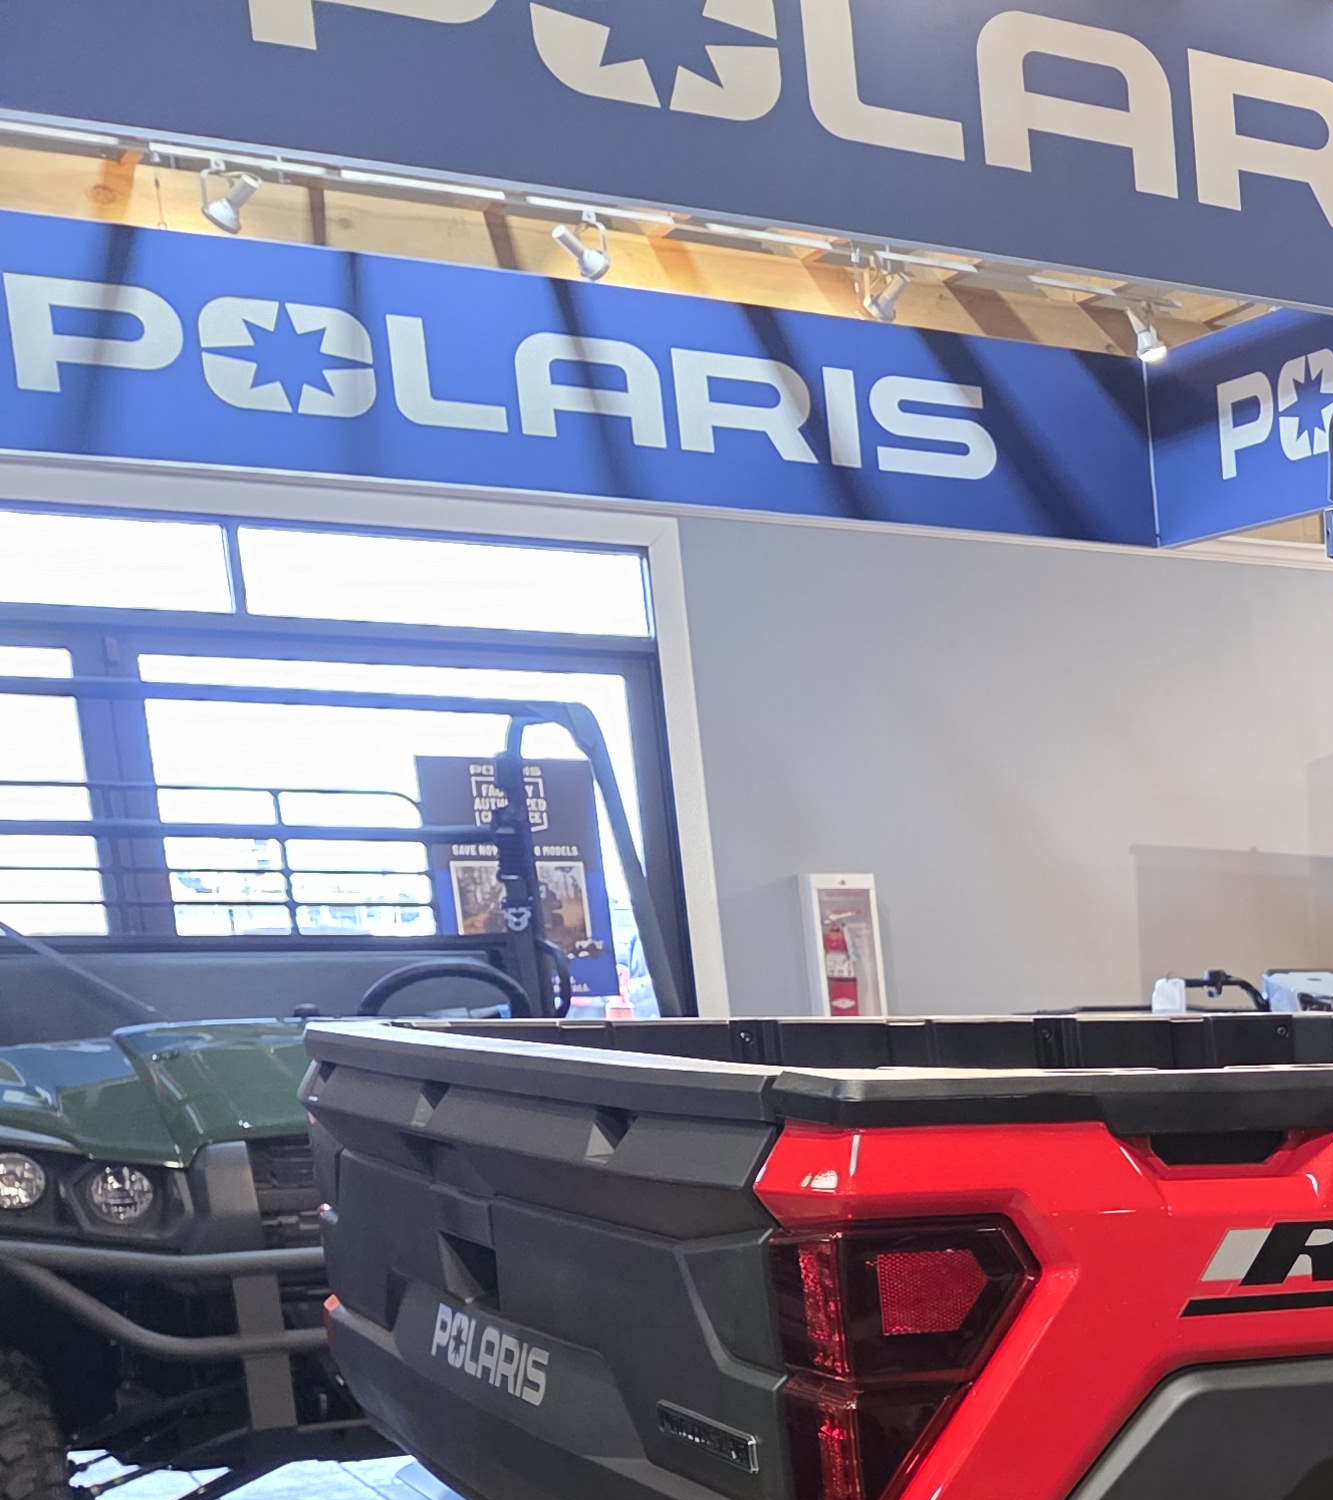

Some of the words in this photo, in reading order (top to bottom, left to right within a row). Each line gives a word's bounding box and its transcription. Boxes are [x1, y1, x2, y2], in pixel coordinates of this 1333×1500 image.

[3, 272, 997, 481] POLARIS
[469, 764, 541, 777] POIS
[452, 844, 477, 856] SAVE
[431, 1302, 550, 1407] POLARIS
